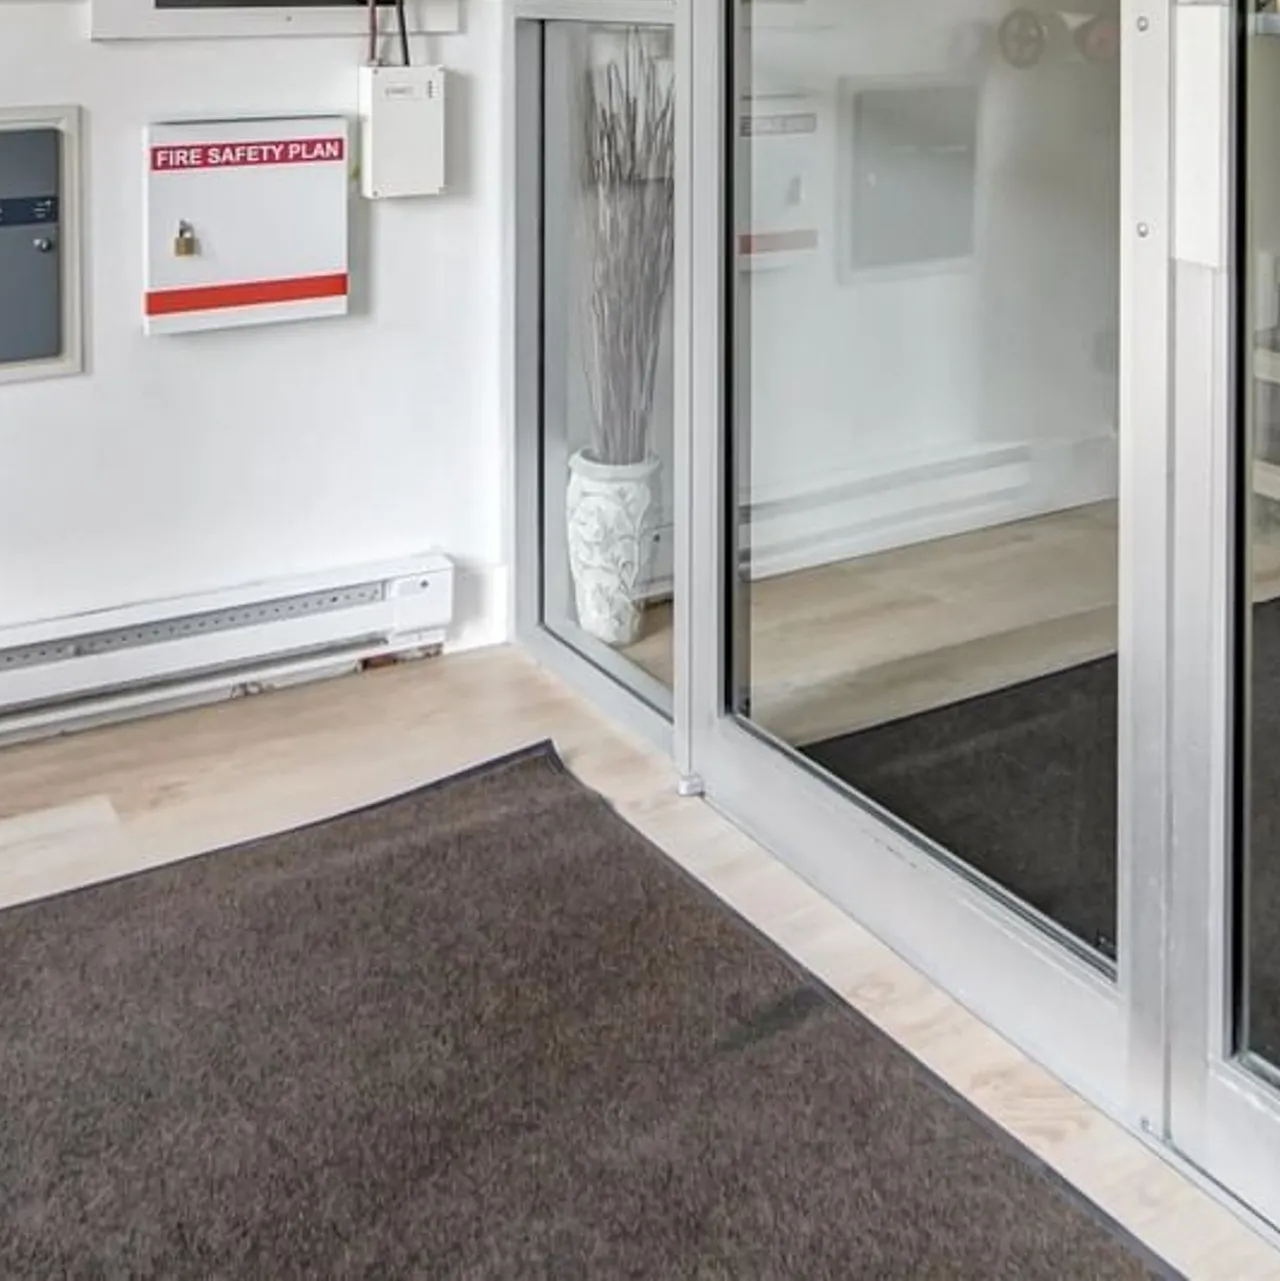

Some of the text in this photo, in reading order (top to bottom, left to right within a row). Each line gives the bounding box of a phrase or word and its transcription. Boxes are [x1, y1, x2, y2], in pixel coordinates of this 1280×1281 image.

[156, 141, 340, 168] FIRE SAFETY PLAN
